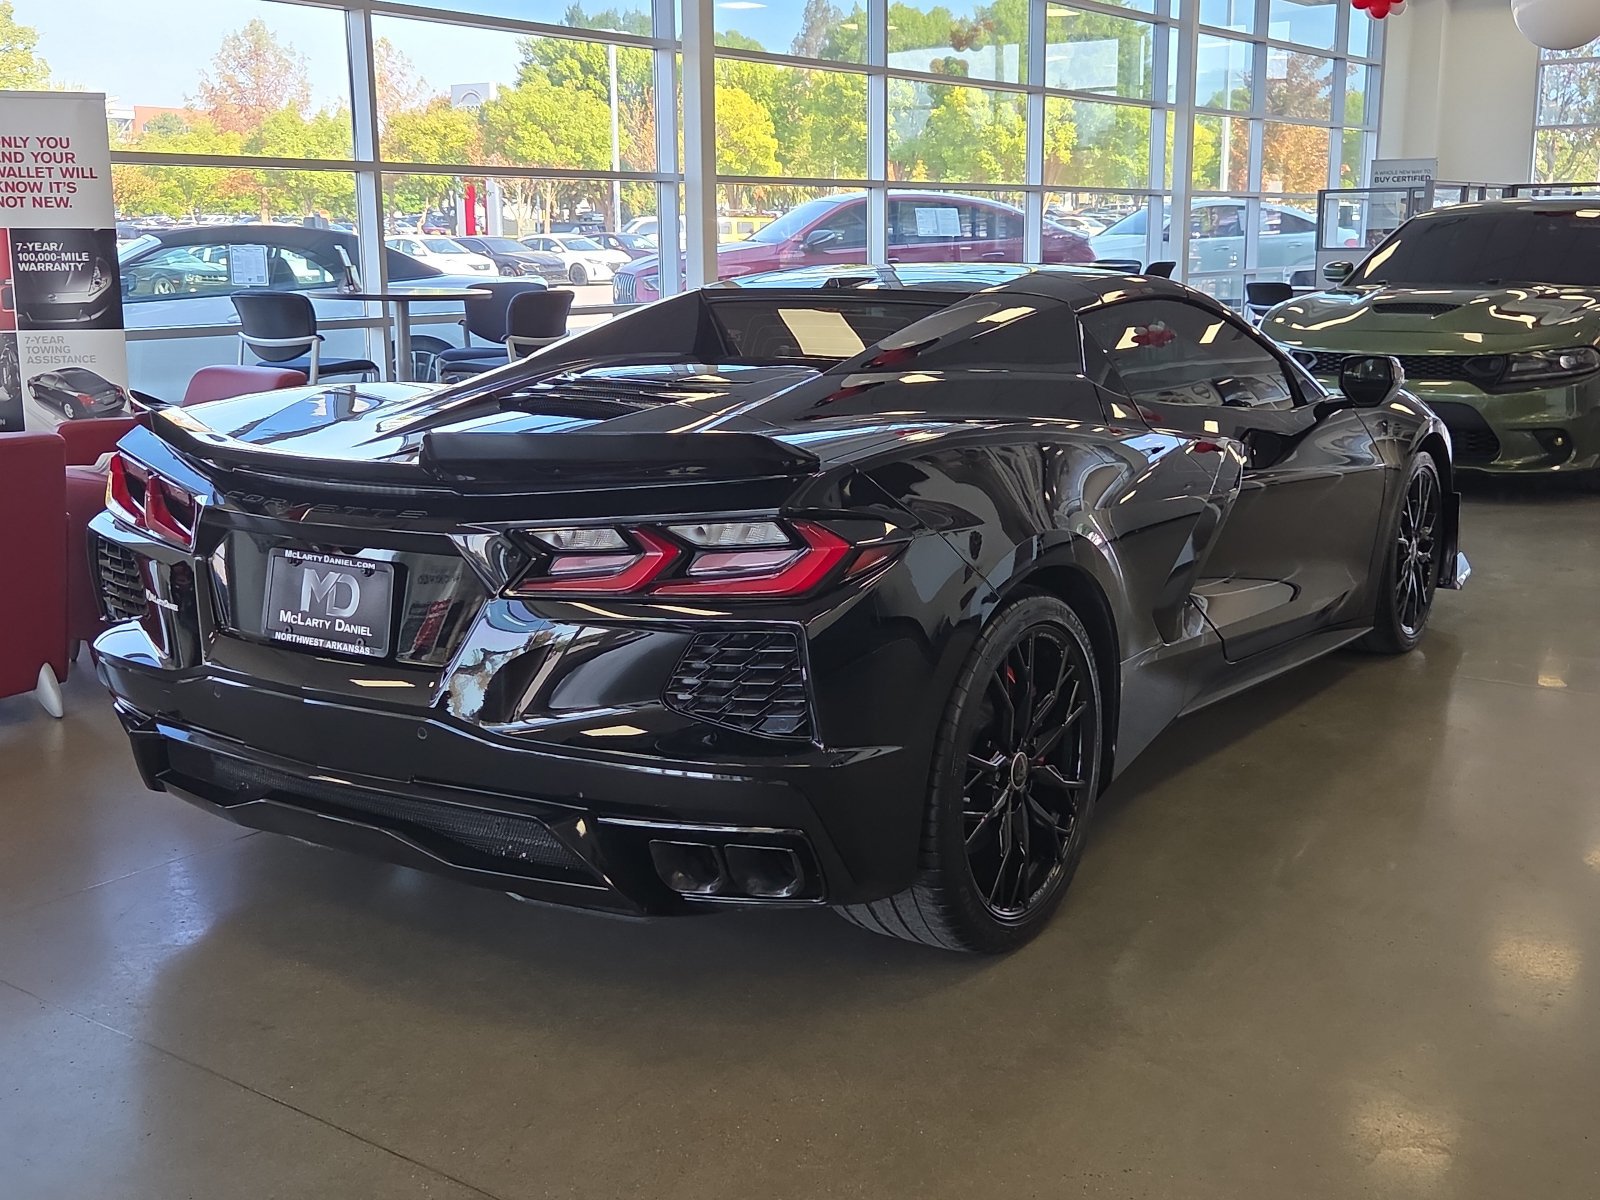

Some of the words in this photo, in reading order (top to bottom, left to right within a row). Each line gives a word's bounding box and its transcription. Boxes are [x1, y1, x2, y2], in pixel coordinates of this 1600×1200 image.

[0, 136, 29, 149] NLY
[36, 136, 70, 149] YOU
[0, 151, 25, 163] ND
[31, 151, 76, 164] YOUR
[60, 167, 98, 179] WILL
[1375, 176, 1391, 184] BUY
[1392, 175, 1431, 183] CERTIFIED
[0, 181, 43, 193] NOW
[49, 181, 77, 194] IT'S
[32, 196, 73, 208] NEW.
[16, 242, 64, 252] 7-YEAR/
[17, 252, 90, 262] 100,000-MILE
[17, 262, 85, 272] WARRANTY
[24, 336, 65, 344] 7-YEAR
[25, 345, 71, 354] TOWING
[26, 355, 97, 364] ASSISTANCE
[274, 631, 325, 647] NORTHWEST
[325, 640, 371, 656] ARKANSAS
